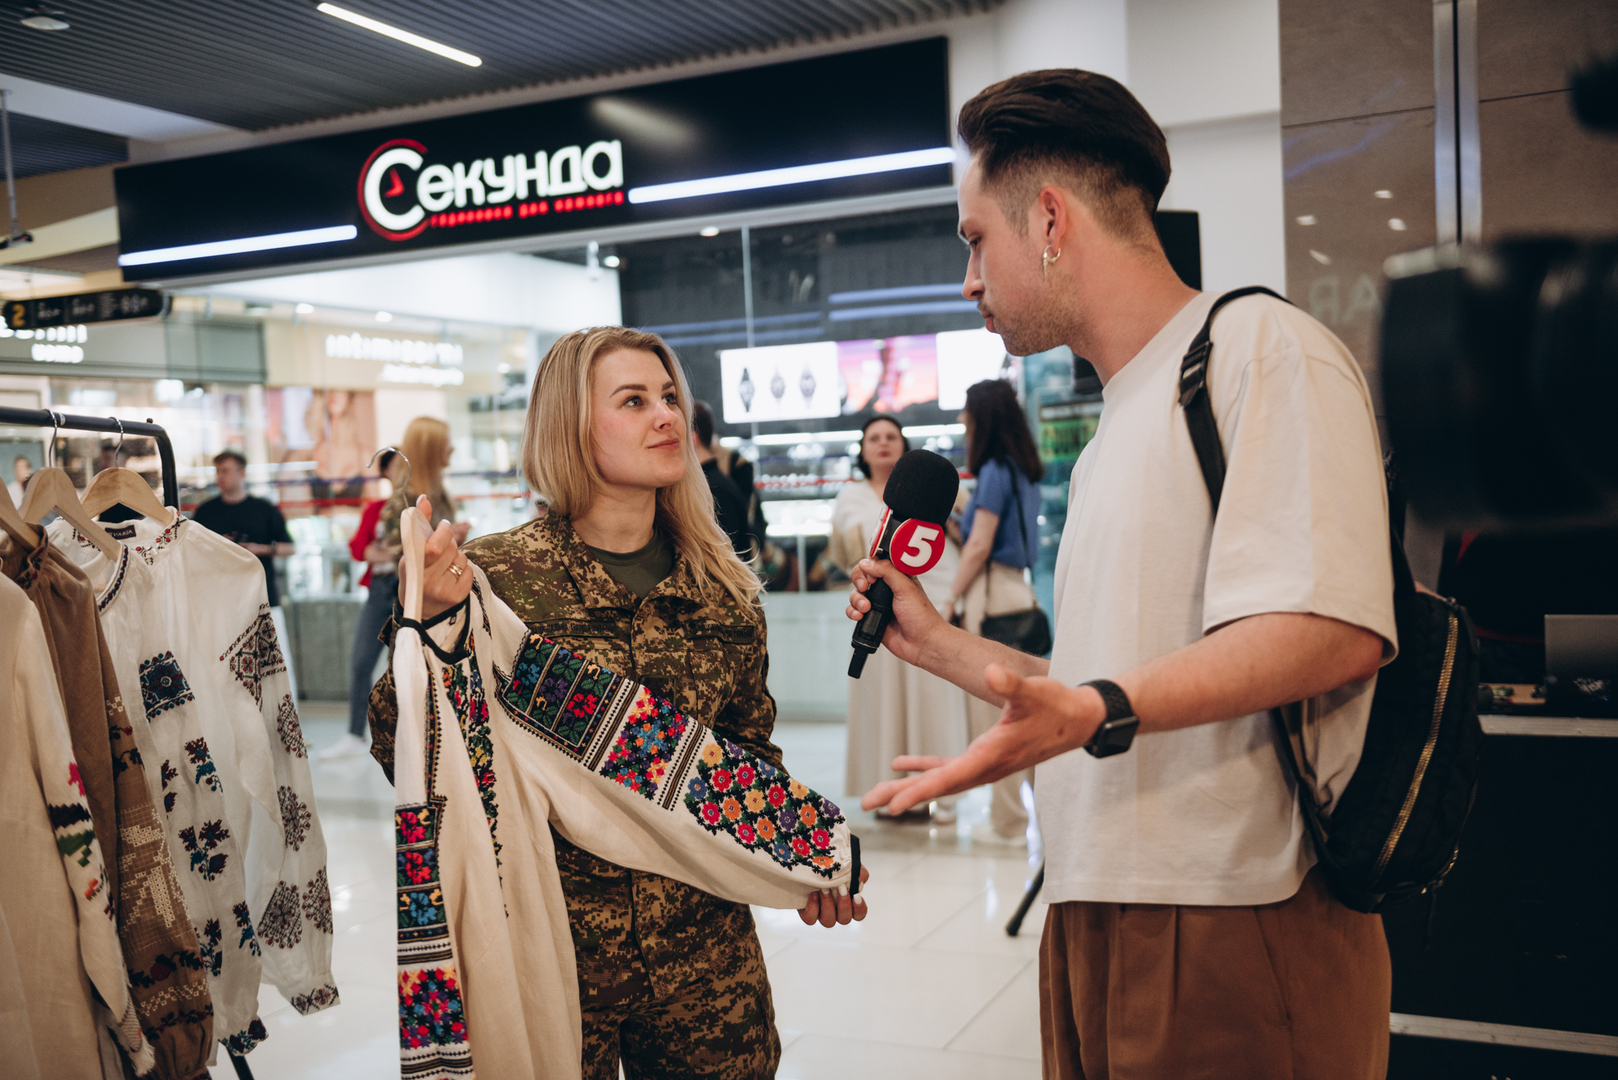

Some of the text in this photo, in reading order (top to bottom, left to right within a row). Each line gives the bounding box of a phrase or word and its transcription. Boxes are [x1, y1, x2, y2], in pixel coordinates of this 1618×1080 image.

[364, 139, 624, 231] Секунда
[12, 303, 26, 328] 2
[900, 525, 940, 568] 5
